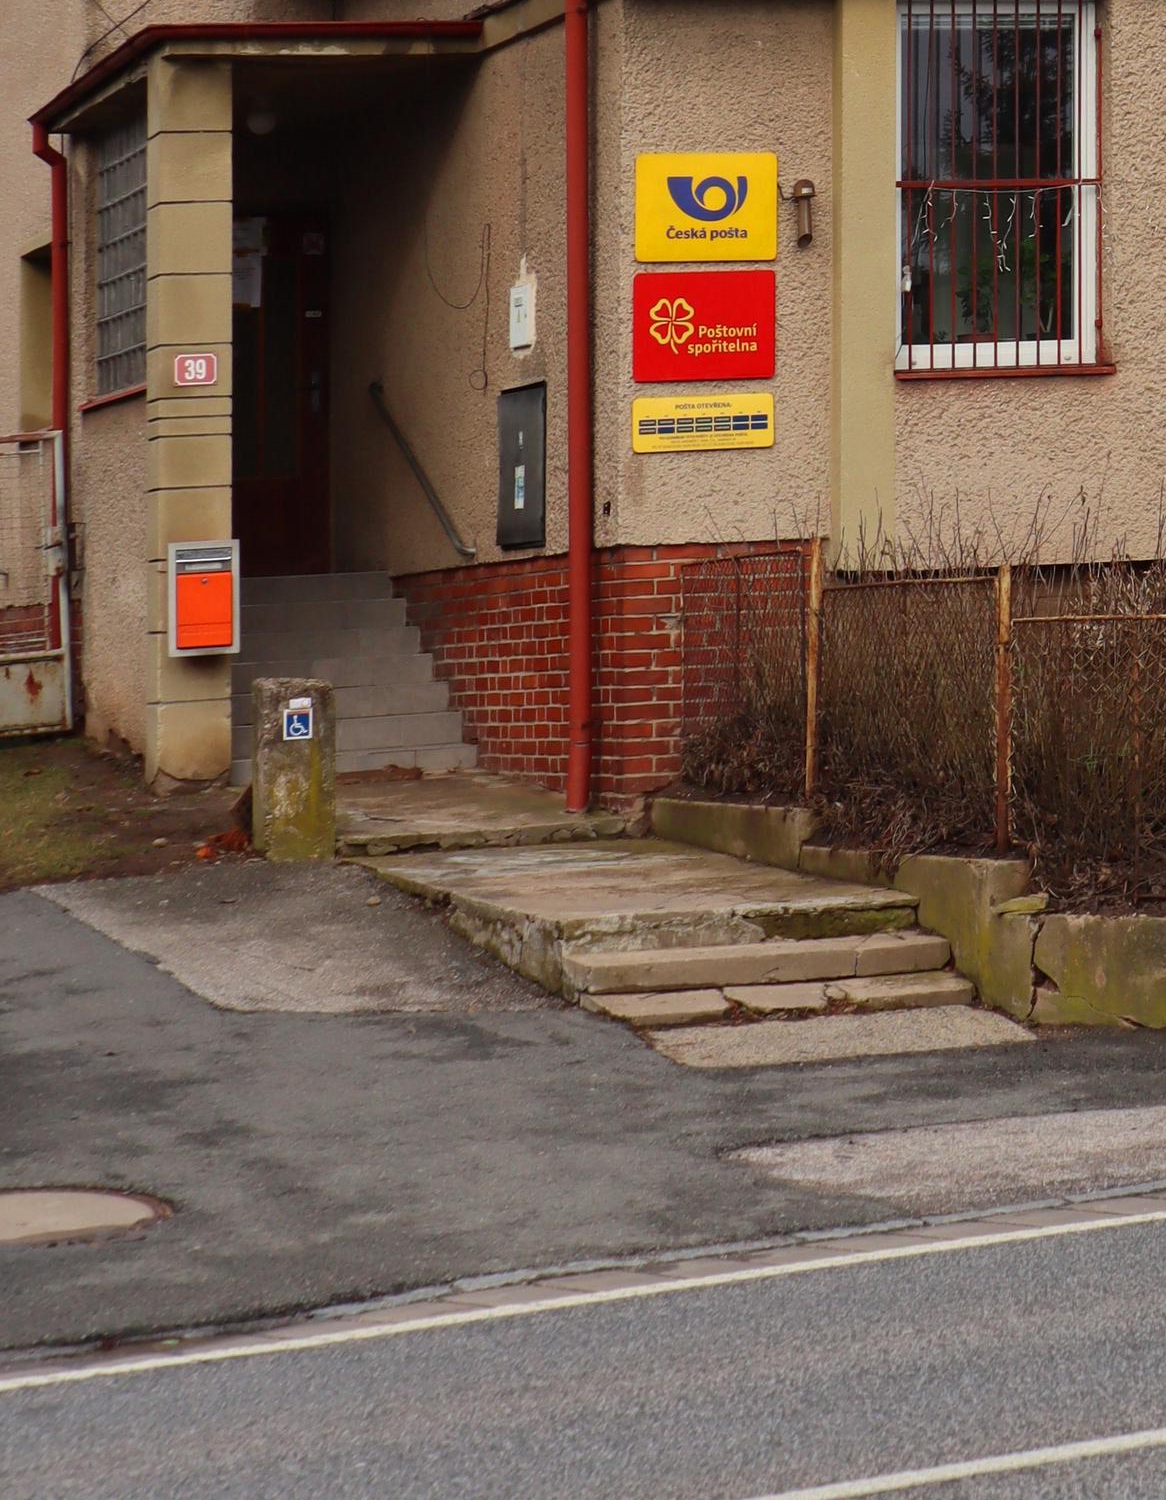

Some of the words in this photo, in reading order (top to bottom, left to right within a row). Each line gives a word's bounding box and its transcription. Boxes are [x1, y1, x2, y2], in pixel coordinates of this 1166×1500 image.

[666, 225, 707, 239] Česká
[710, 227, 747, 241] pošta
[698, 323, 757, 338] Poštovní
[687, 339, 757, 356] spořitelna
[184, 359, 206, 379] 39
